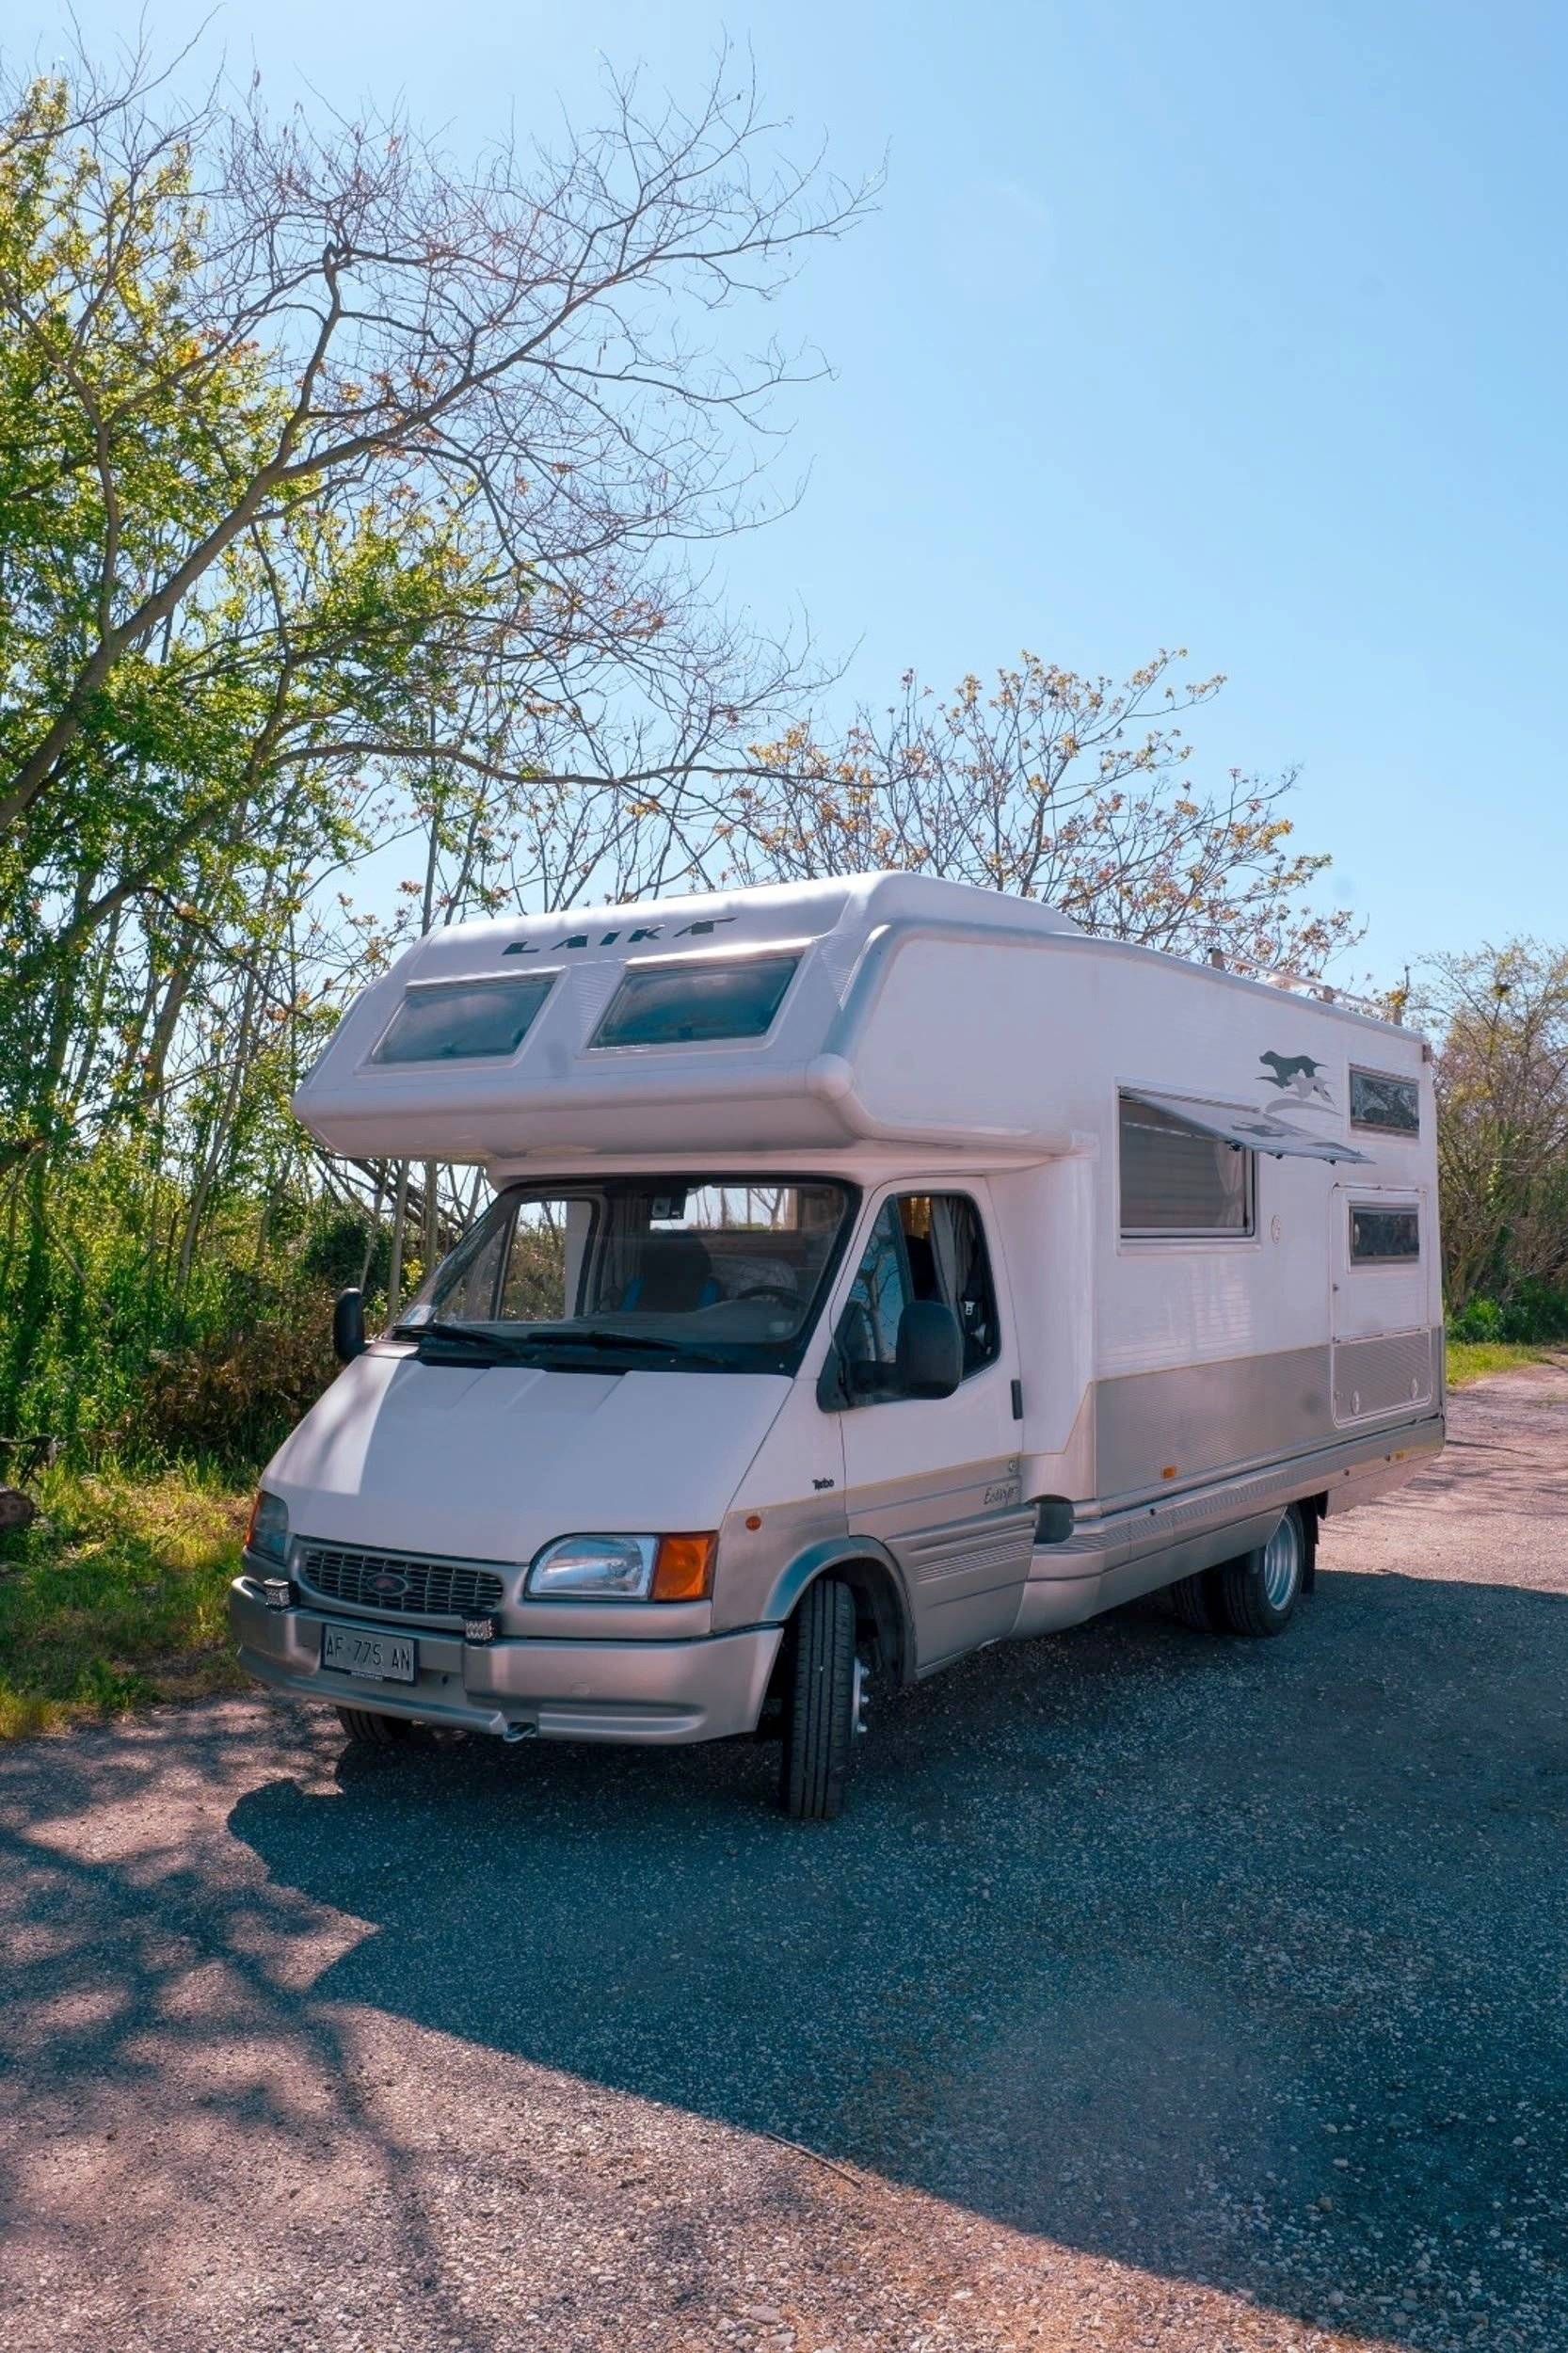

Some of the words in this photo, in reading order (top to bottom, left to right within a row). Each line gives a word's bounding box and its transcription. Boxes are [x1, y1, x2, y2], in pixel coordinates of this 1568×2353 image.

[502, 917, 737, 955] LAIKA
[326, 1635, 345, 1657] AF
[353, 1639, 383, 1666] 775
[392, 1648, 410, 1672] AN
